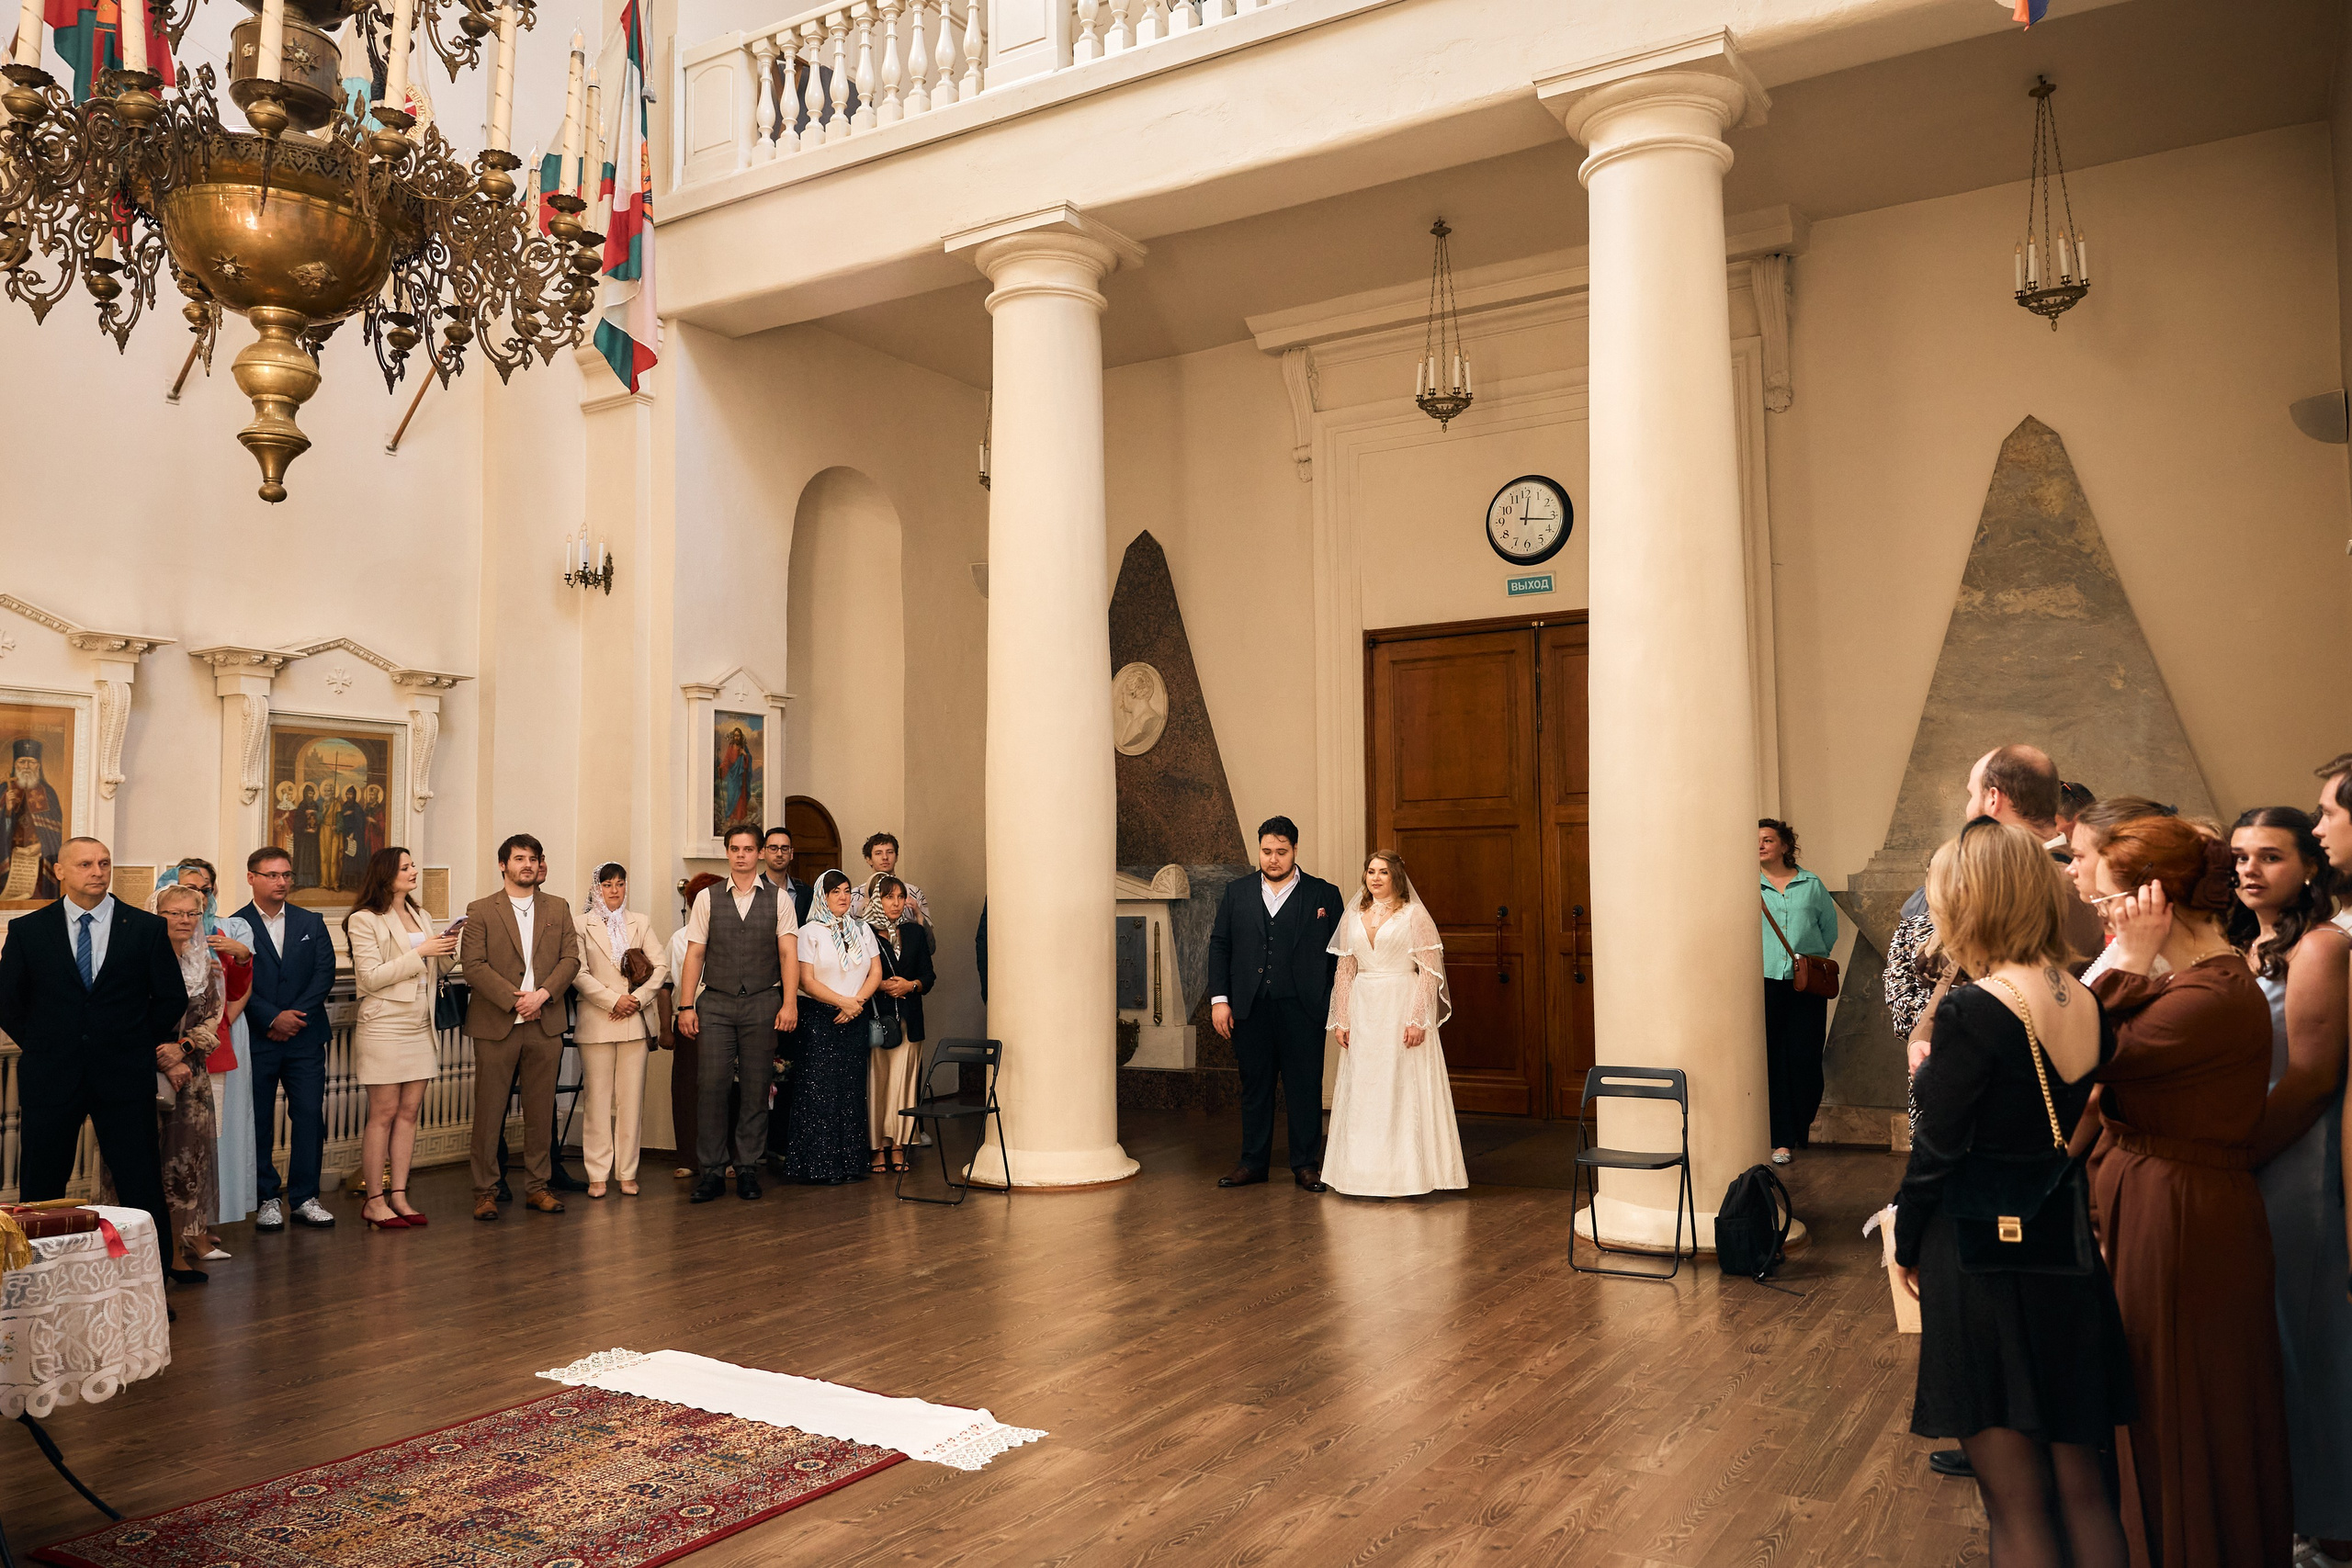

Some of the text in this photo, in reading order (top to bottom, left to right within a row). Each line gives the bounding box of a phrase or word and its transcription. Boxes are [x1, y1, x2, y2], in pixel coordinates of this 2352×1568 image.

[1510, 494, 1519, 504] 11
[1521, 489, 1531, 499] 12
[1544, 498, 1551, 507] 2
[1502, 505, 1512, 515] 10
[1550, 510, 1556, 520] 3
[1498, 517, 1506, 527] 9
[1544, 524, 1553, 533] 4
[1502, 529, 1510, 539] 8
[1537, 534, 1544, 544] 5
[1513, 536, 1520, 547] 7
[1523, 539, 1532, 549] 6
[1510, 579, 1550, 592] ВЫХОД
